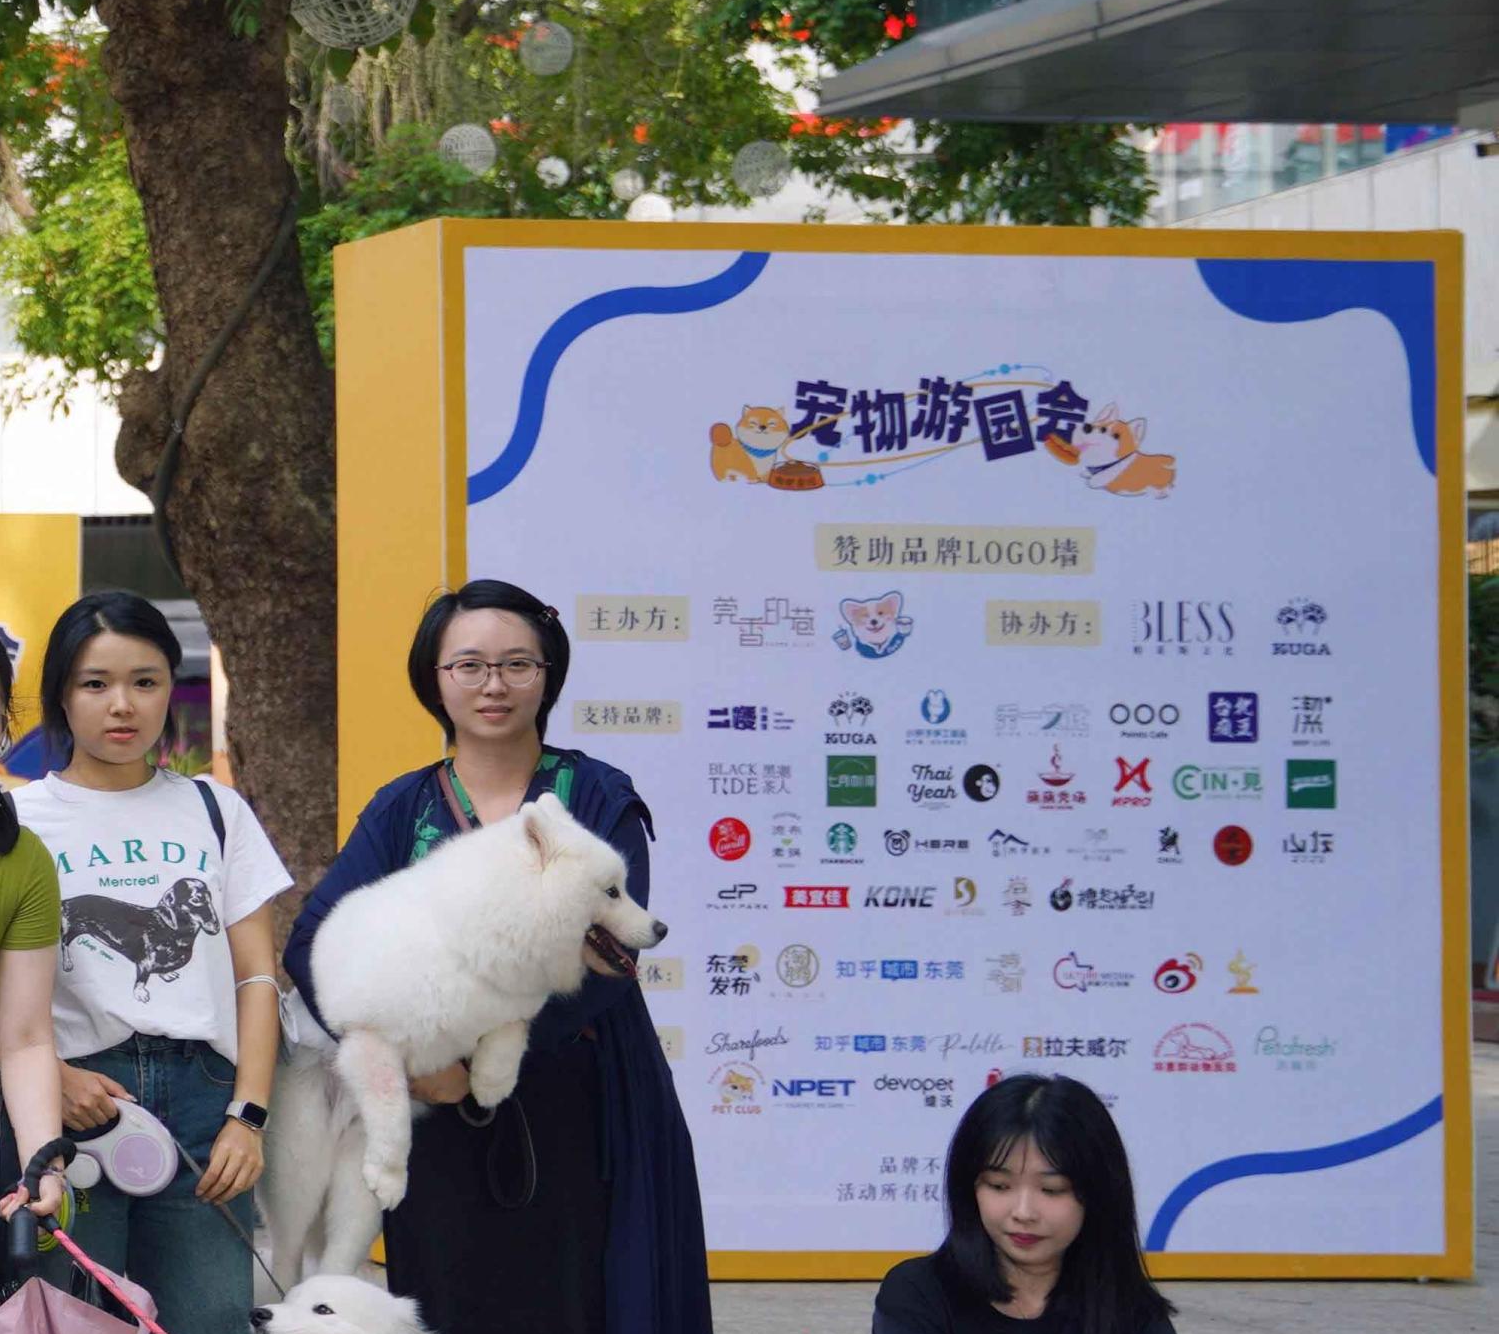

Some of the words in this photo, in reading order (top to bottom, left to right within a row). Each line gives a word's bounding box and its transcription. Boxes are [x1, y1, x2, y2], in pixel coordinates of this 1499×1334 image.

[789, 375, 1089, 462] 宠物游园会
[833, 537, 1080, 569] 赞助品牌LOGO墙
[1271, 643, 1332, 657] KUGA
[824, 732, 877, 745] KUGA
[708, 763, 758, 776] BLACK
[911, 764, 954, 782] Thai
[906, 784, 957, 803] Yeah
[98, 874, 160, 888] Mercredi
[864, 885, 938, 908] KONE
[705, 954, 749, 974] 东莞
[709, 975, 752, 996] 发布
[1044, 1036, 1128, 1059] 拉夫威尔
[772, 1079, 857, 1097] NPET
[873, 1074, 955, 1096] devopet
[837, 1182, 941, 1203] 活动所有权
